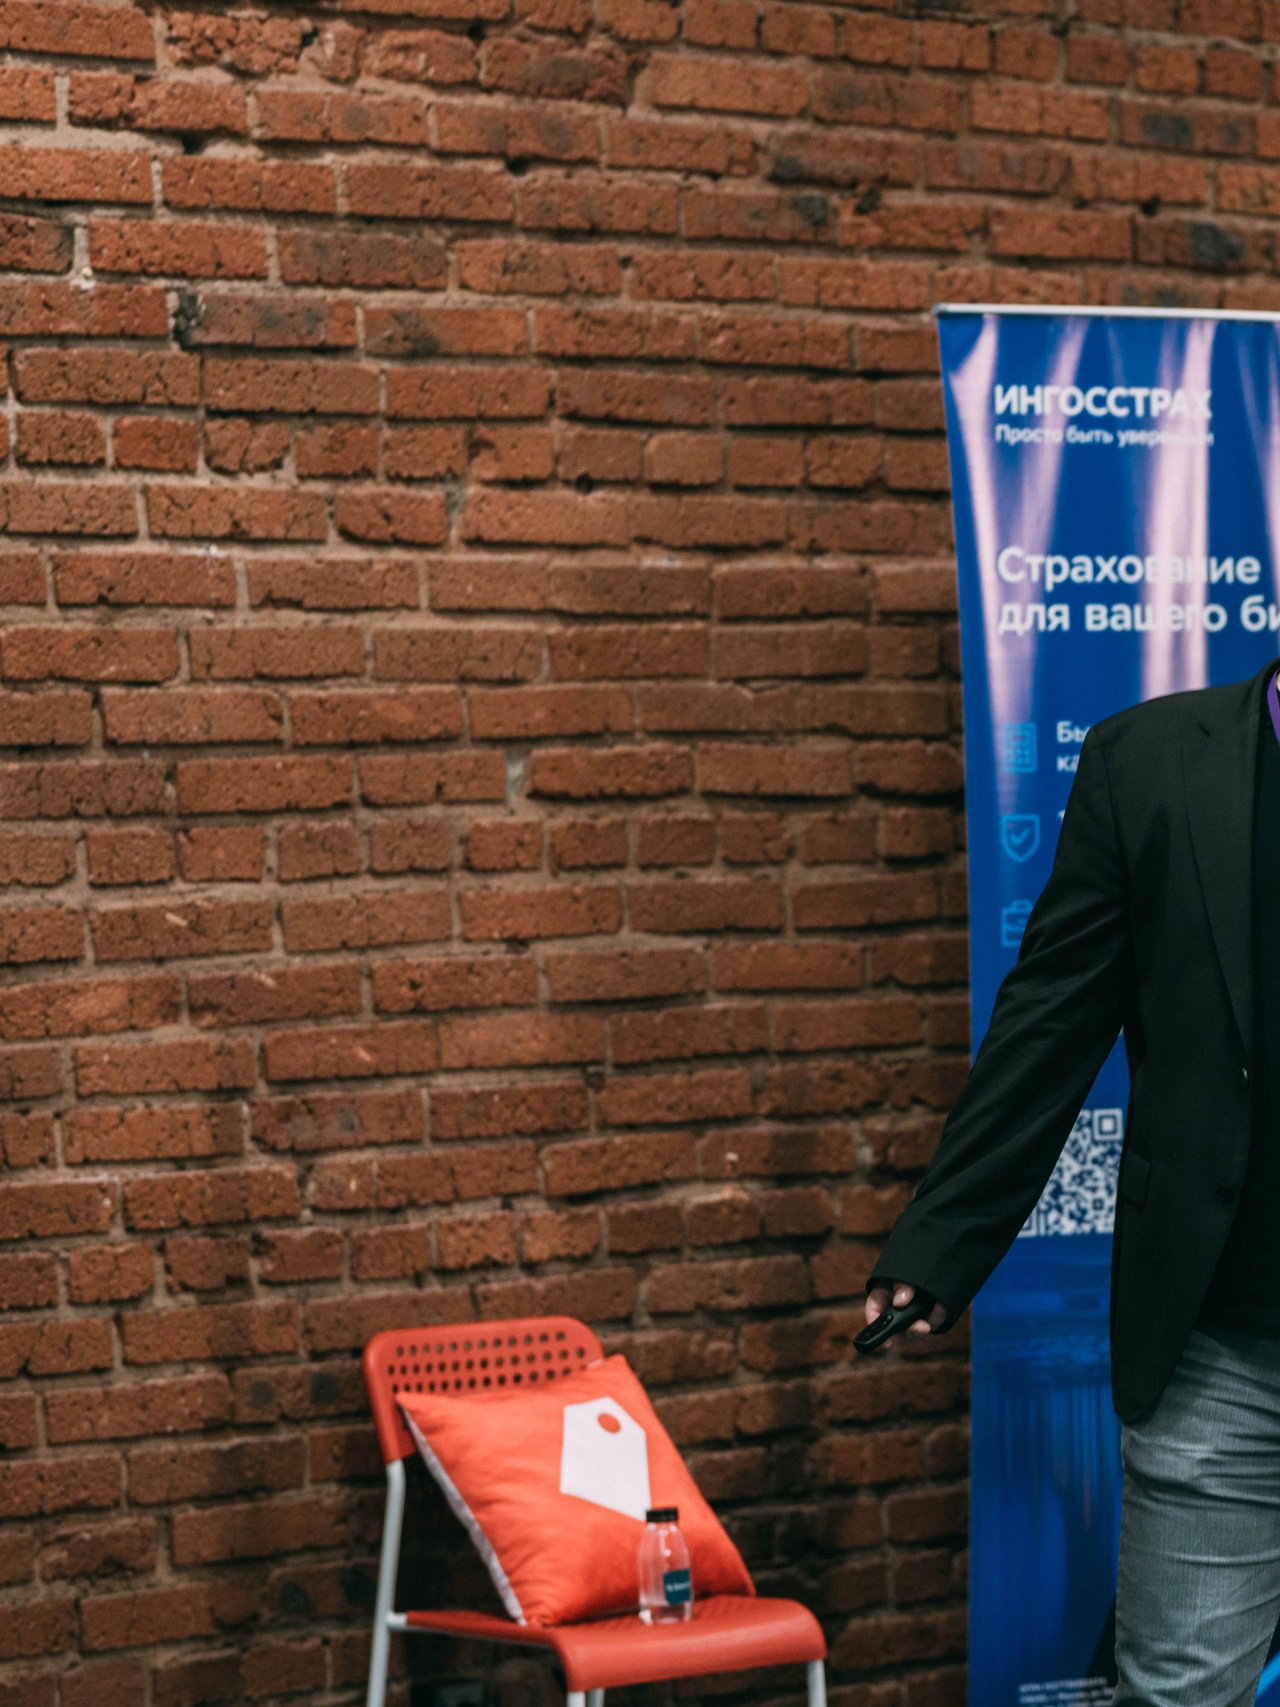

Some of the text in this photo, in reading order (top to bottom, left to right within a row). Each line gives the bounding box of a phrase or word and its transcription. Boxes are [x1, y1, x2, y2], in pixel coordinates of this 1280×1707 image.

[994, 384, 1213, 419] ИНГОССТРАХ
[995, 424, 1063, 446] Просто
[1066, 425, 1114, 444] быть
[998, 547, 1262, 592] Страхование
[998, 604, 1071, 636] для
[1085, 603, 1228, 633] вашего
